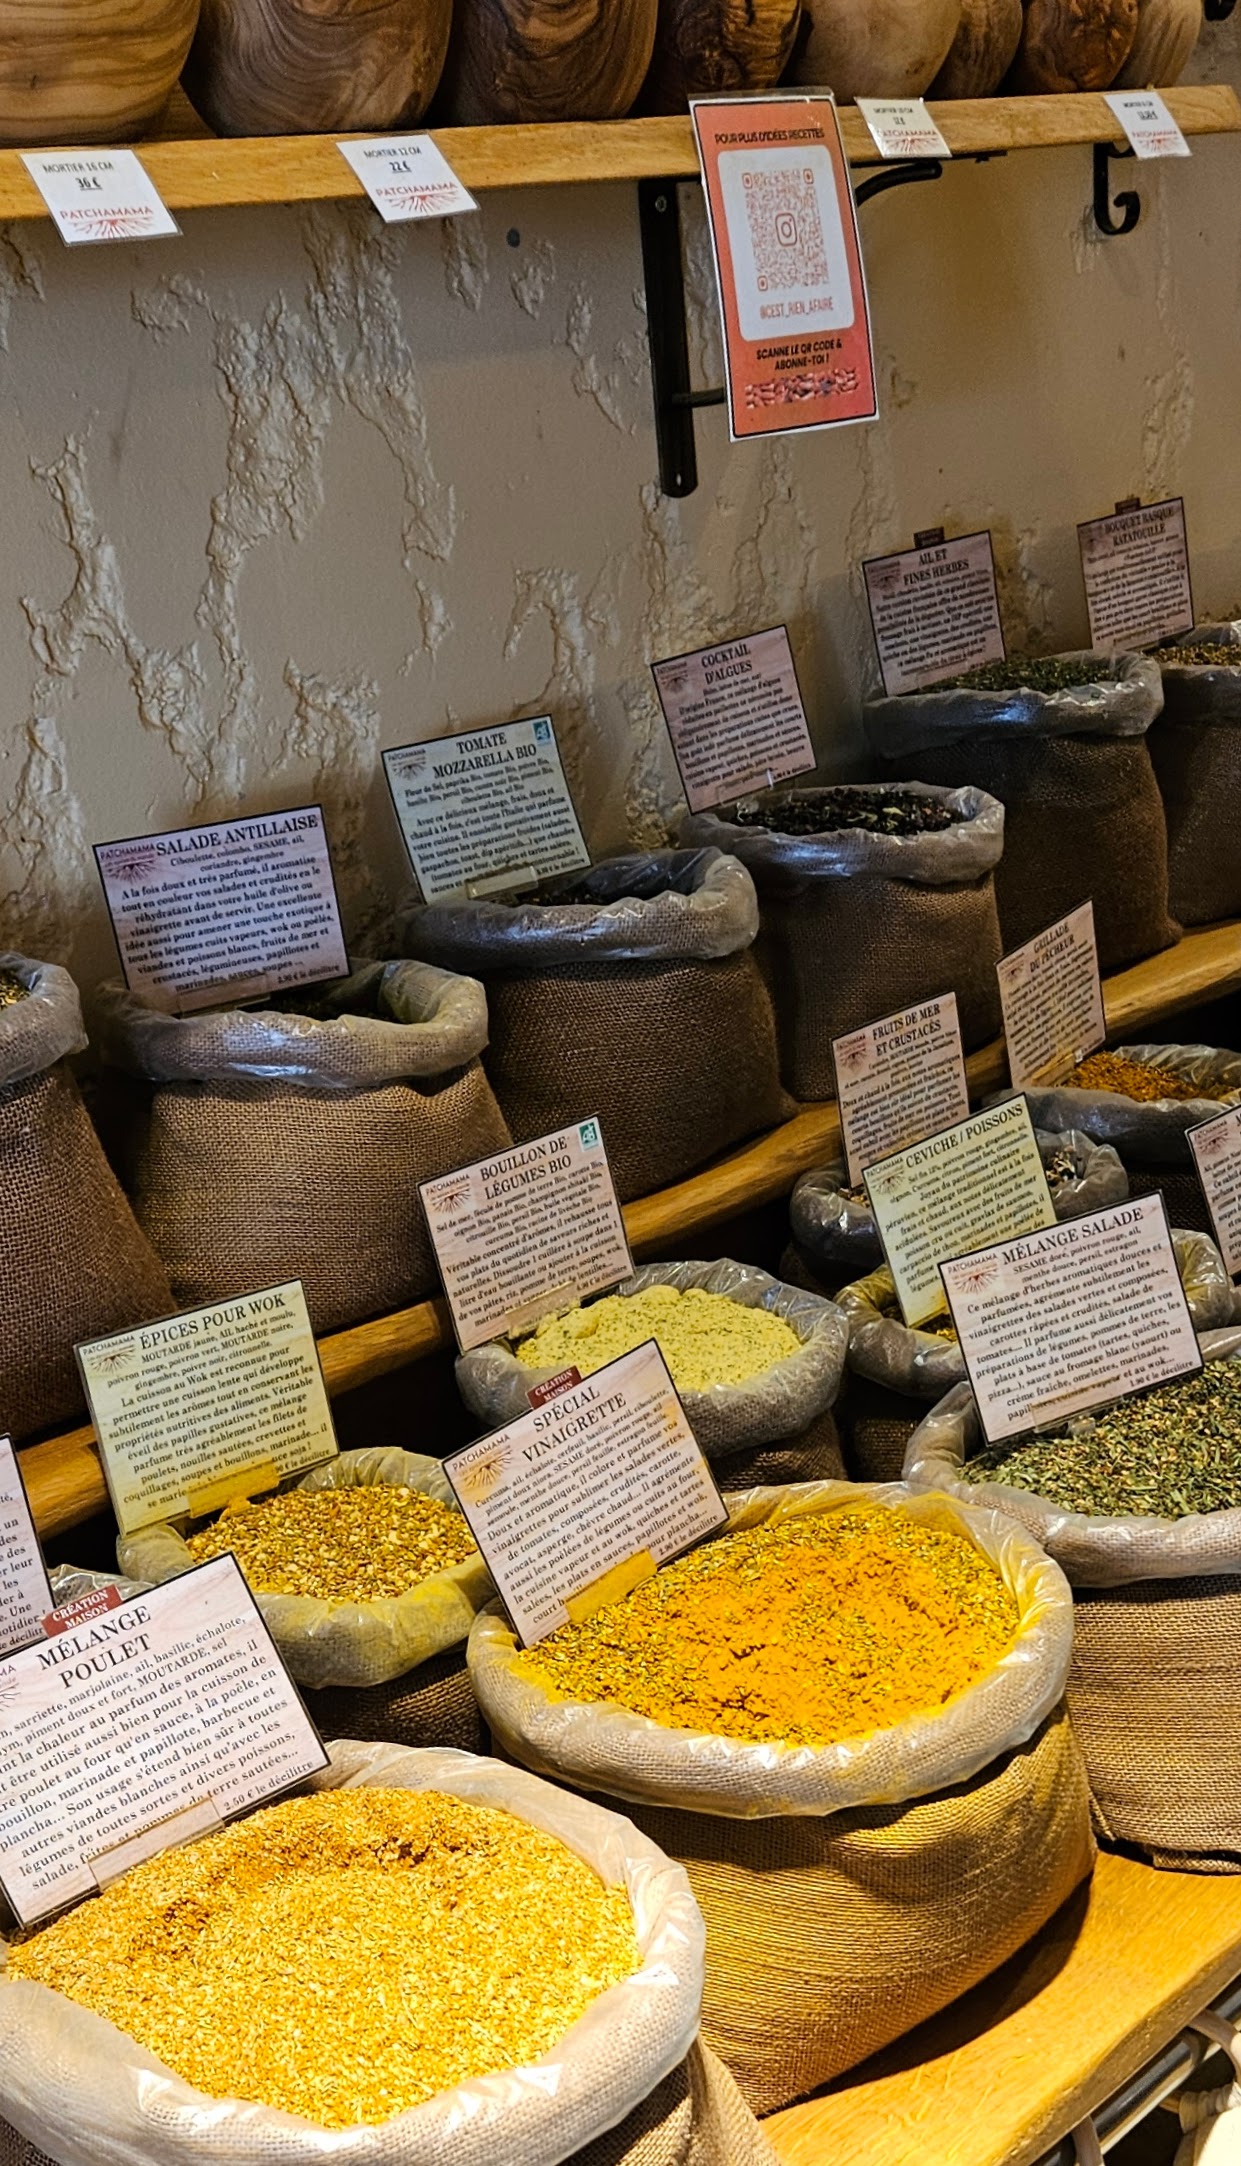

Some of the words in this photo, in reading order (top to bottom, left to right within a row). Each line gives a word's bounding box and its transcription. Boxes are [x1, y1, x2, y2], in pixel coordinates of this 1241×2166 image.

[363, 148, 399, 159] MORTIER
[397, 147, 409, 157] 12
[407, 146, 422, 156] CM
[715, 132, 738, 145] POUR
[739, 131, 758, 144] PLUS
[788, 127, 825, 140] RECETTES
[41, 162, 86, 174] MORTIER
[85, 161, 99, 172] 16
[97, 161, 115, 171] CM
[75, 176, 93, 189] 36
[91, 176, 102, 189] €
[388, 161, 404, 173] 22
[402, 160, 411, 171] €
[375, 181, 458, 197] PATCHAMAMA
[59, 205, 154, 220] PATCHAMAMA
[756, 345, 790, 361] SCANNE
[790, 343, 800, 357] LE
[800, 341, 813, 356] QR
[812, 338, 835, 354] CODE
[835, 337, 843, 349] &
[774, 353, 825, 371] ABONNE-TOI
[902, 567, 932, 587] FINES
[931, 558, 970, 579] HERBES
[918, 551, 936, 567] AIL
[934, 547, 948, 563] ET
[700, 643, 752, 669] COCKTAIL
[704, 659, 753, 686] D'ALGUES
[455, 731, 508, 755] TOMATE
[432, 749, 515, 780] MOZZARELLA
[515, 743, 537, 760] BIO
[155, 832, 222, 857] SALADE
[224, 814, 319, 845] ANTILLAISE
[130, 888, 141, 898] la
[141, 885, 160, 897] fois
[160, 881, 186, 893] doux
[186, 878, 198, 887] et
[198, 874, 218, 885] très
[218, 865, 261, 882] parfumé,
[261, 862, 270, 873] il
[270, 856, 317, 872] aromatise
[1033, 921, 1070, 955] GRILLADE
[872, 1017, 904, 1041] FRUITS
[904, 1011, 918, 1027] DE
[918, 1003, 941, 1022] MER
[875, 1041, 888, 1057] ET
[888, 1018, 942, 1051] CRUSTACÉS
[905, 1133, 959, 1169] CEVICHE
[959, 1130, 964, 1143] /
[965, 1103, 1024, 1141] POISSONS
[479, 1143, 547, 1182] BOUILLON
[548, 1135, 568, 1155] DE
[484, 1164, 547, 1201] LÉGUMES
[547, 1154, 572, 1175] BIO
[1001, 1228, 1079, 1266] MÉLANGE
[1081, 1207, 1144, 1239] SALADE
[947, 1252, 998, 1275] PATCHAMAMA
[967, 1303, 980, 1314] Ce
[981, 1291, 1021, 1310] mélange
[1022, 1277, 1061, 1297] d'herbes
[1062, 1258, 1119, 1283] aromatiques
[1119, 1247, 1152, 1264] douces
[1152, 1242, 1163, 1252] et
[139, 1319, 199, 1350] ÉPICES
[201, 1305, 247, 1331] POUR
[247, 1292, 286, 1315] WOK
[82, 1334, 136, 1356] PATCHAMAMA
[120, 1397, 135, 1408] La
[136, 1385, 173, 1403] cuisson
[173, 1381, 186, 1391] au
[185, 1371, 209, 1386] Wok
[209, 1367, 224, 1379] est
[224, 1354, 267, 1374] reconnue
[268, 1346, 290, 1362] pour
[1151, 1372, 1160, 1380] le
[1160, 1360, 1194, 1377] décilitre
[543, 1380, 573, 1402] MAISON
[532, 1385, 601, 1433] SPÉCIAL
[521, 1392, 627, 1462] VINAIGRETTE
[140, 1465, 179, 1486] poulets,
[179, 1451, 217, 1470] nouilles
[217, 1439, 255, 1457] sautées,
[254, 1423, 296, 1443] crevettes
[296, 1418, 307, 1428] et
[451, 1433, 511, 1472] PATCHAMAMA
[491, 1517, 547, 1555] vinaigrettes
[547, 1503, 570, 1523] pour
[570, 1478, 609, 1507] sublimer
[609, 1469, 624, 1482] les
[624, 1449, 657, 1474] salades
[655, 1432, 685, 1453] vertes,
[678, 1534, 687, 1543] le
[687, 1514, 718, 1538] décilitre
[7, 1546, 26, 1559] des
[10, 1558, 33, 1573] leur
[9, 1604, 32, 1617] Une
[52, 1589, 108, 1622] CRÉATION
[64, 1603, 109, 1629] MAISON
[35, 1605, 152, 1671] MÉLANGE
[58, 1633, 151, 1689] POULET
[16, 1751, 34, 1764] la
[35, 1725, 85, 1756] chaleur
[88, 1716, 107, 1730] au
[108, 1691, 158, 1722] parfum
[159, 1679, 182, 1695] des
[183, 1649, 247, 1684] aromates,
[246, 1638, 258, 1652] il
[18, 1774, 62, 1805] poulet
[64, 1765, 82, 1780] au
[83, 1749, 112, 1770] four
[115, 1731, 151, 1755] qu'en
[152, 1712, 194, 1735] sauce,
[194, 1702, 205, 1714] à
[204, 1697, 219, 1709] la
[220, 1679, 260, 1704] poêle,
[260, 1669, 277, 1682] en
[21, 1831, 65, 1859] autres
[65, 1803, 118, 1834] viandes
[117, 1773, 177, 1807] blanches
[179, 1752, 211, 1777] ainsi
[213, 1730, 261, 1761] qu'avec
[260, 1720, 281, 1735] les
[223, 1794, 246, 1811] 2.50
[247, 1788, 255, 1799] €
[254, 1785, 267, 1795] le
[268, 1761, 314, 1789] décilitre
[18, 1843, 75, 1877] légumes
[77, 1834, 94, 1847] de
[96, 1811, 138, 1838] toutes
[139, 1792, 179, 1816] sortes
[180, 1781, 194, 1794] et
[196, 1760, 236, 1786] divers
[237, 1732, 296, 1768] poissons,
